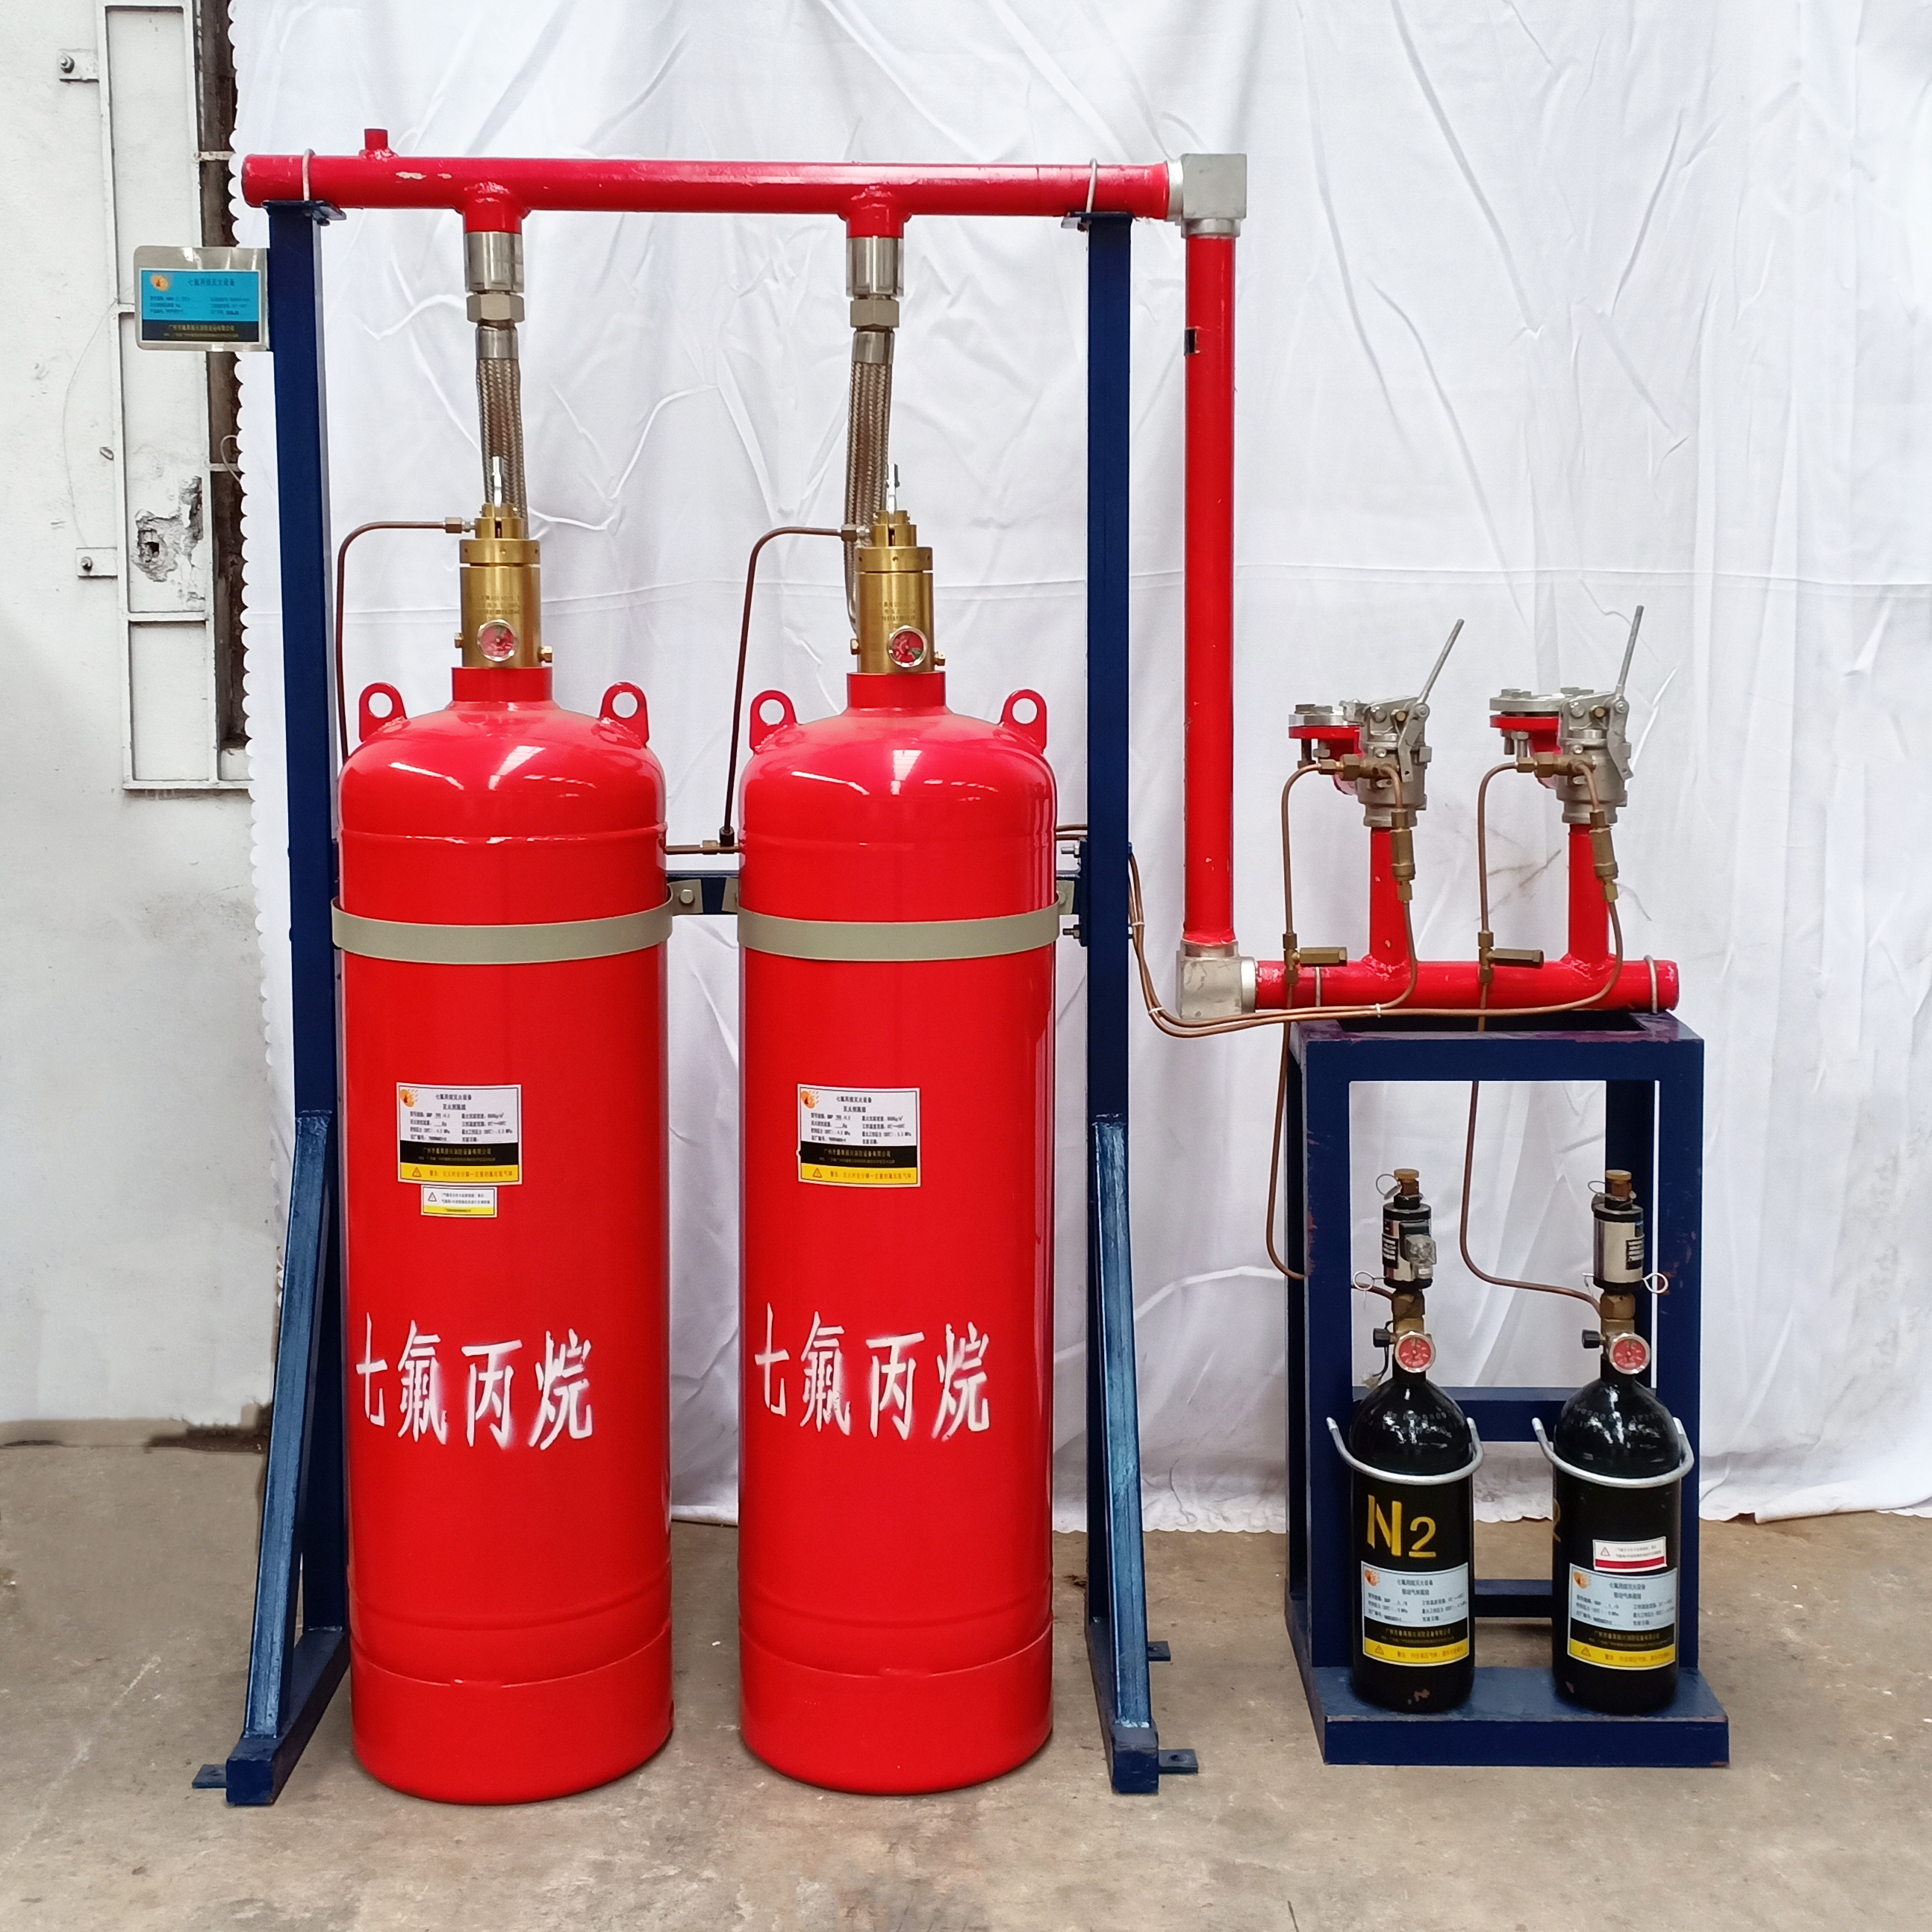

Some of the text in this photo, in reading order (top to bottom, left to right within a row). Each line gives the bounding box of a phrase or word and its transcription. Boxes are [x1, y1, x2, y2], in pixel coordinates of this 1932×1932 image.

[355, 1312, 594, 1450] 七氟丙烷
[754, 1302, 991, 1442] 七氟丙烷
[1367, 1494, 1436, 1558] N2
